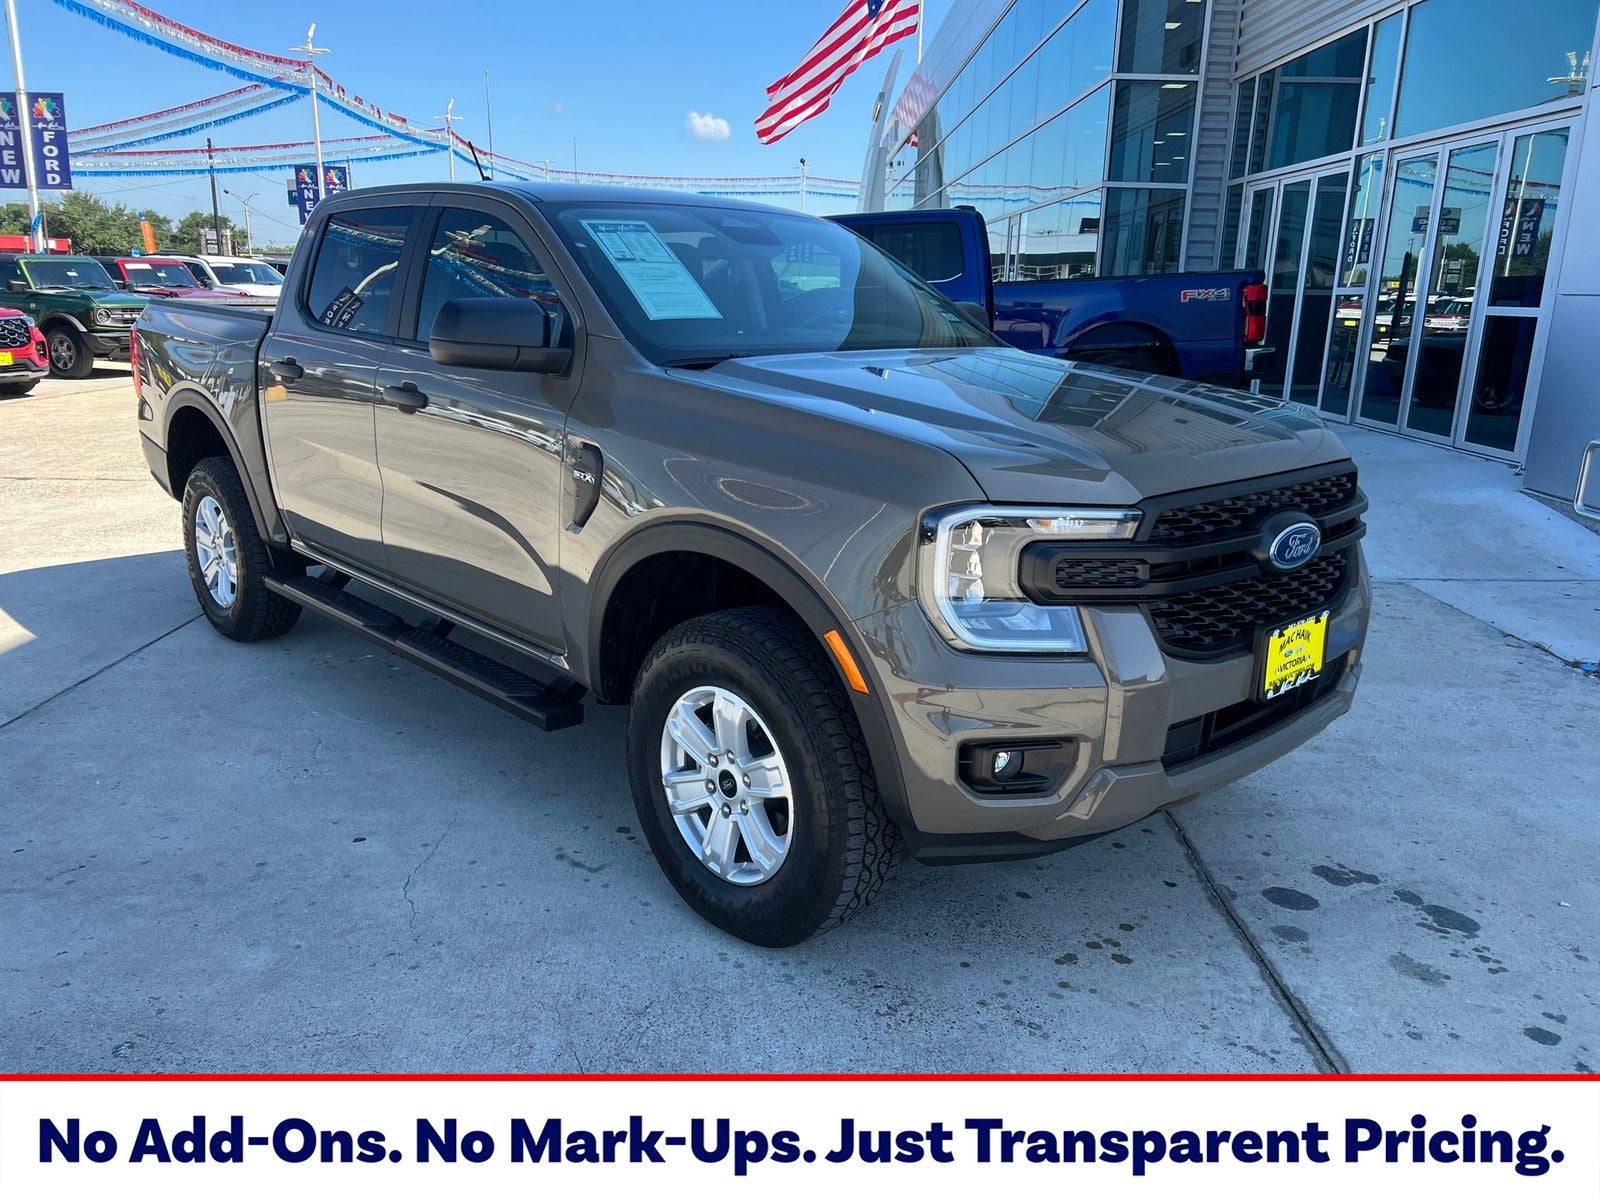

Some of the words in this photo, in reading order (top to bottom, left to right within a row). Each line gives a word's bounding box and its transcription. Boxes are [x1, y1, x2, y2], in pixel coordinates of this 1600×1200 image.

[0, 131, 20, 184] NEW
[42, 131, 61, 185] FORD
[1180, 288, 1231, 301] FX4
[1284, 533, 1314, 560] Ford
[1278, 632, 1296, 655] MAC
[1296, 629, 1312, 642] HAIK
[1277, 655, 1307, 673] VICTORIA
